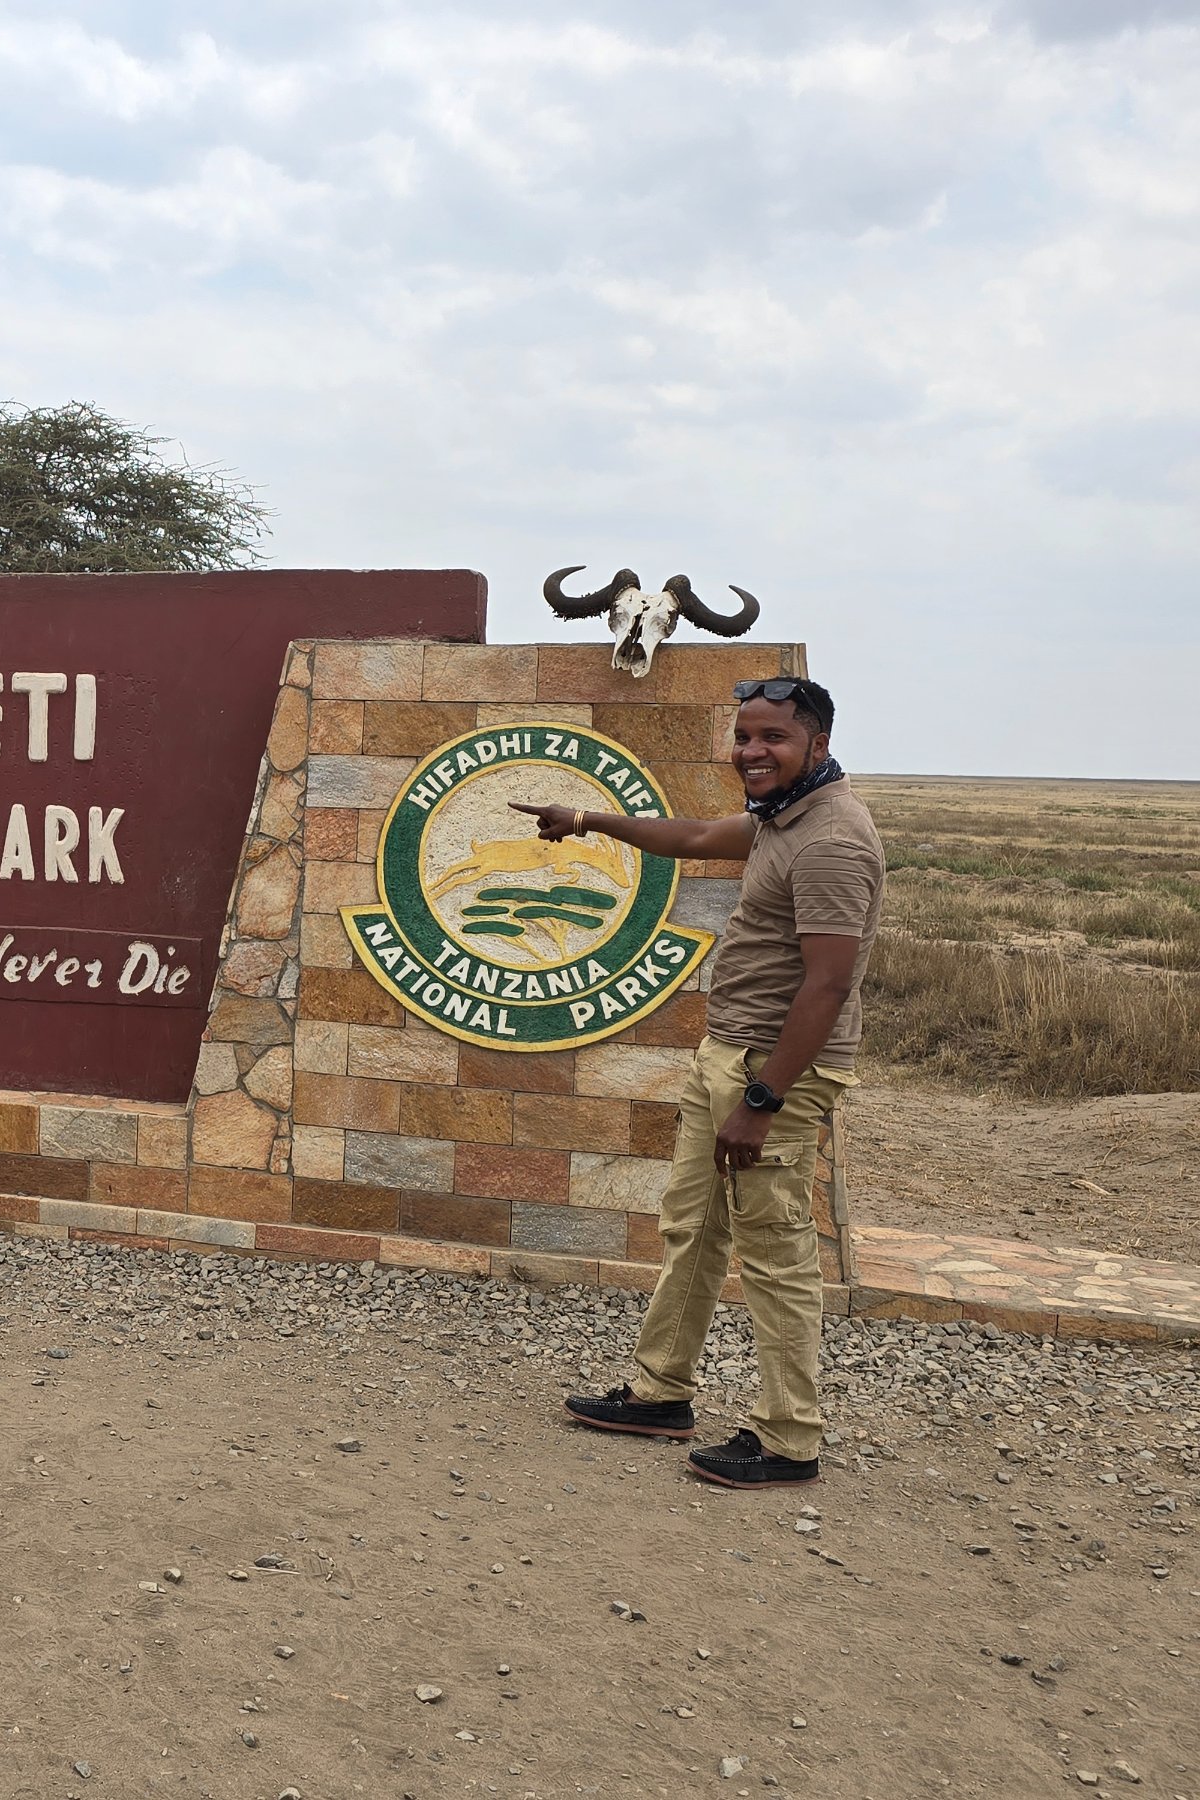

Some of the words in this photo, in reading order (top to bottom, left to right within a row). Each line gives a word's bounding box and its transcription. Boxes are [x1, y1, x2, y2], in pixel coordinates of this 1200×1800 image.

[407, 732, 531, 810] HIFADHI
[545, 733, 579, 760] ZA
[117, 941, 192, 996] Die
[364, 922, 517, 1036] NATIONAL
[568, 938, 686, 1030] PARKS
[433, 939, 611, 1000] TANZANIA
